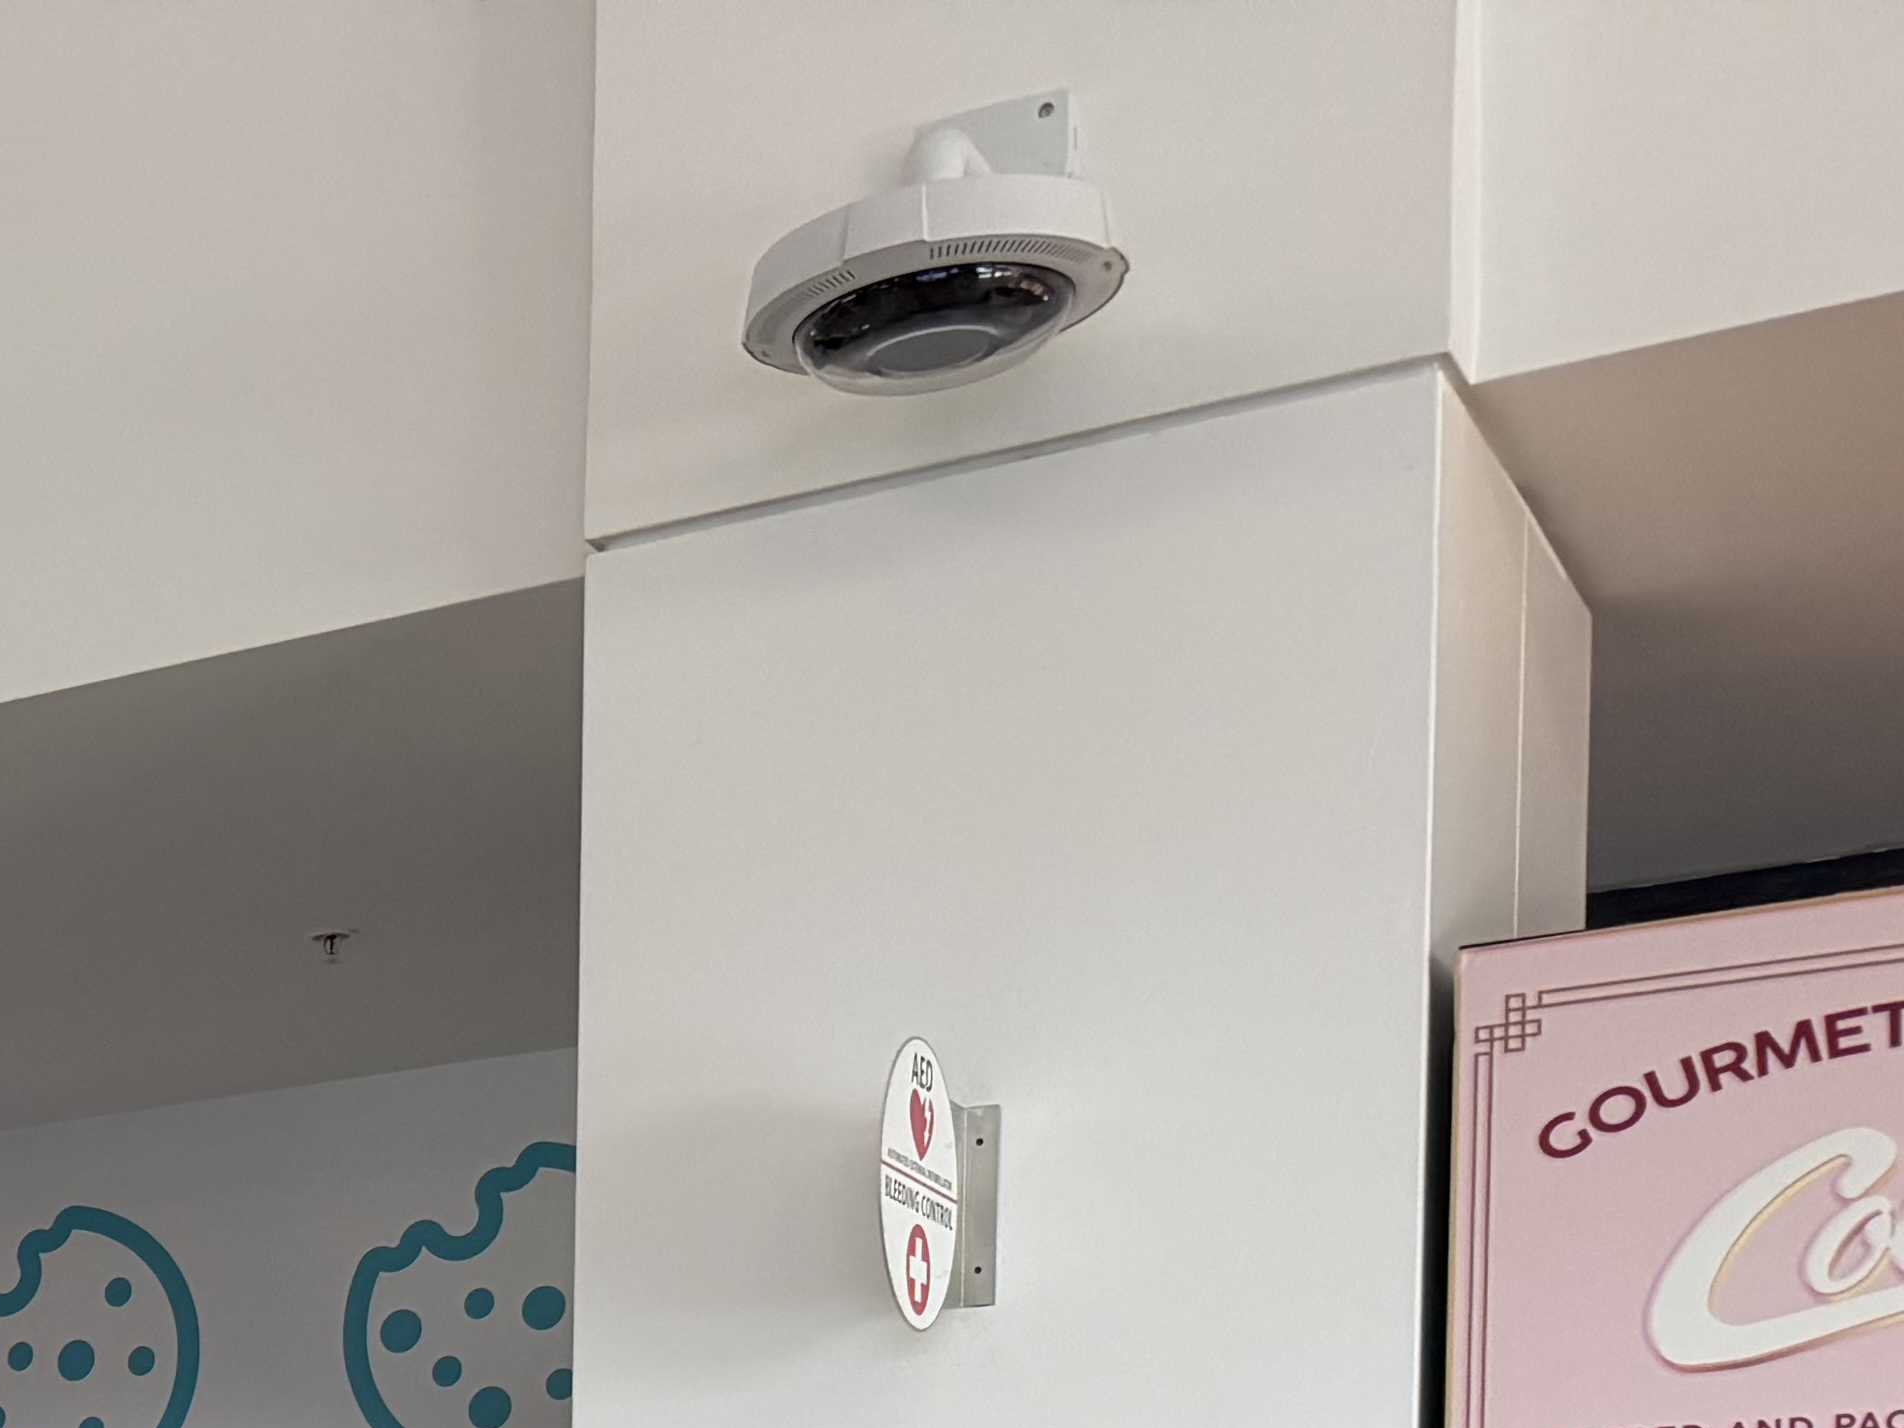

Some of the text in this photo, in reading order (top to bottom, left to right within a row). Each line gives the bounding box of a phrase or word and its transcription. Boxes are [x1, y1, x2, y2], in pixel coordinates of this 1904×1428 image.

[911, 1052, 933, 1092] AED
[921, 1197, 953, 1231] CONTROL
[1650, 1127, 1904, 1373] Co
